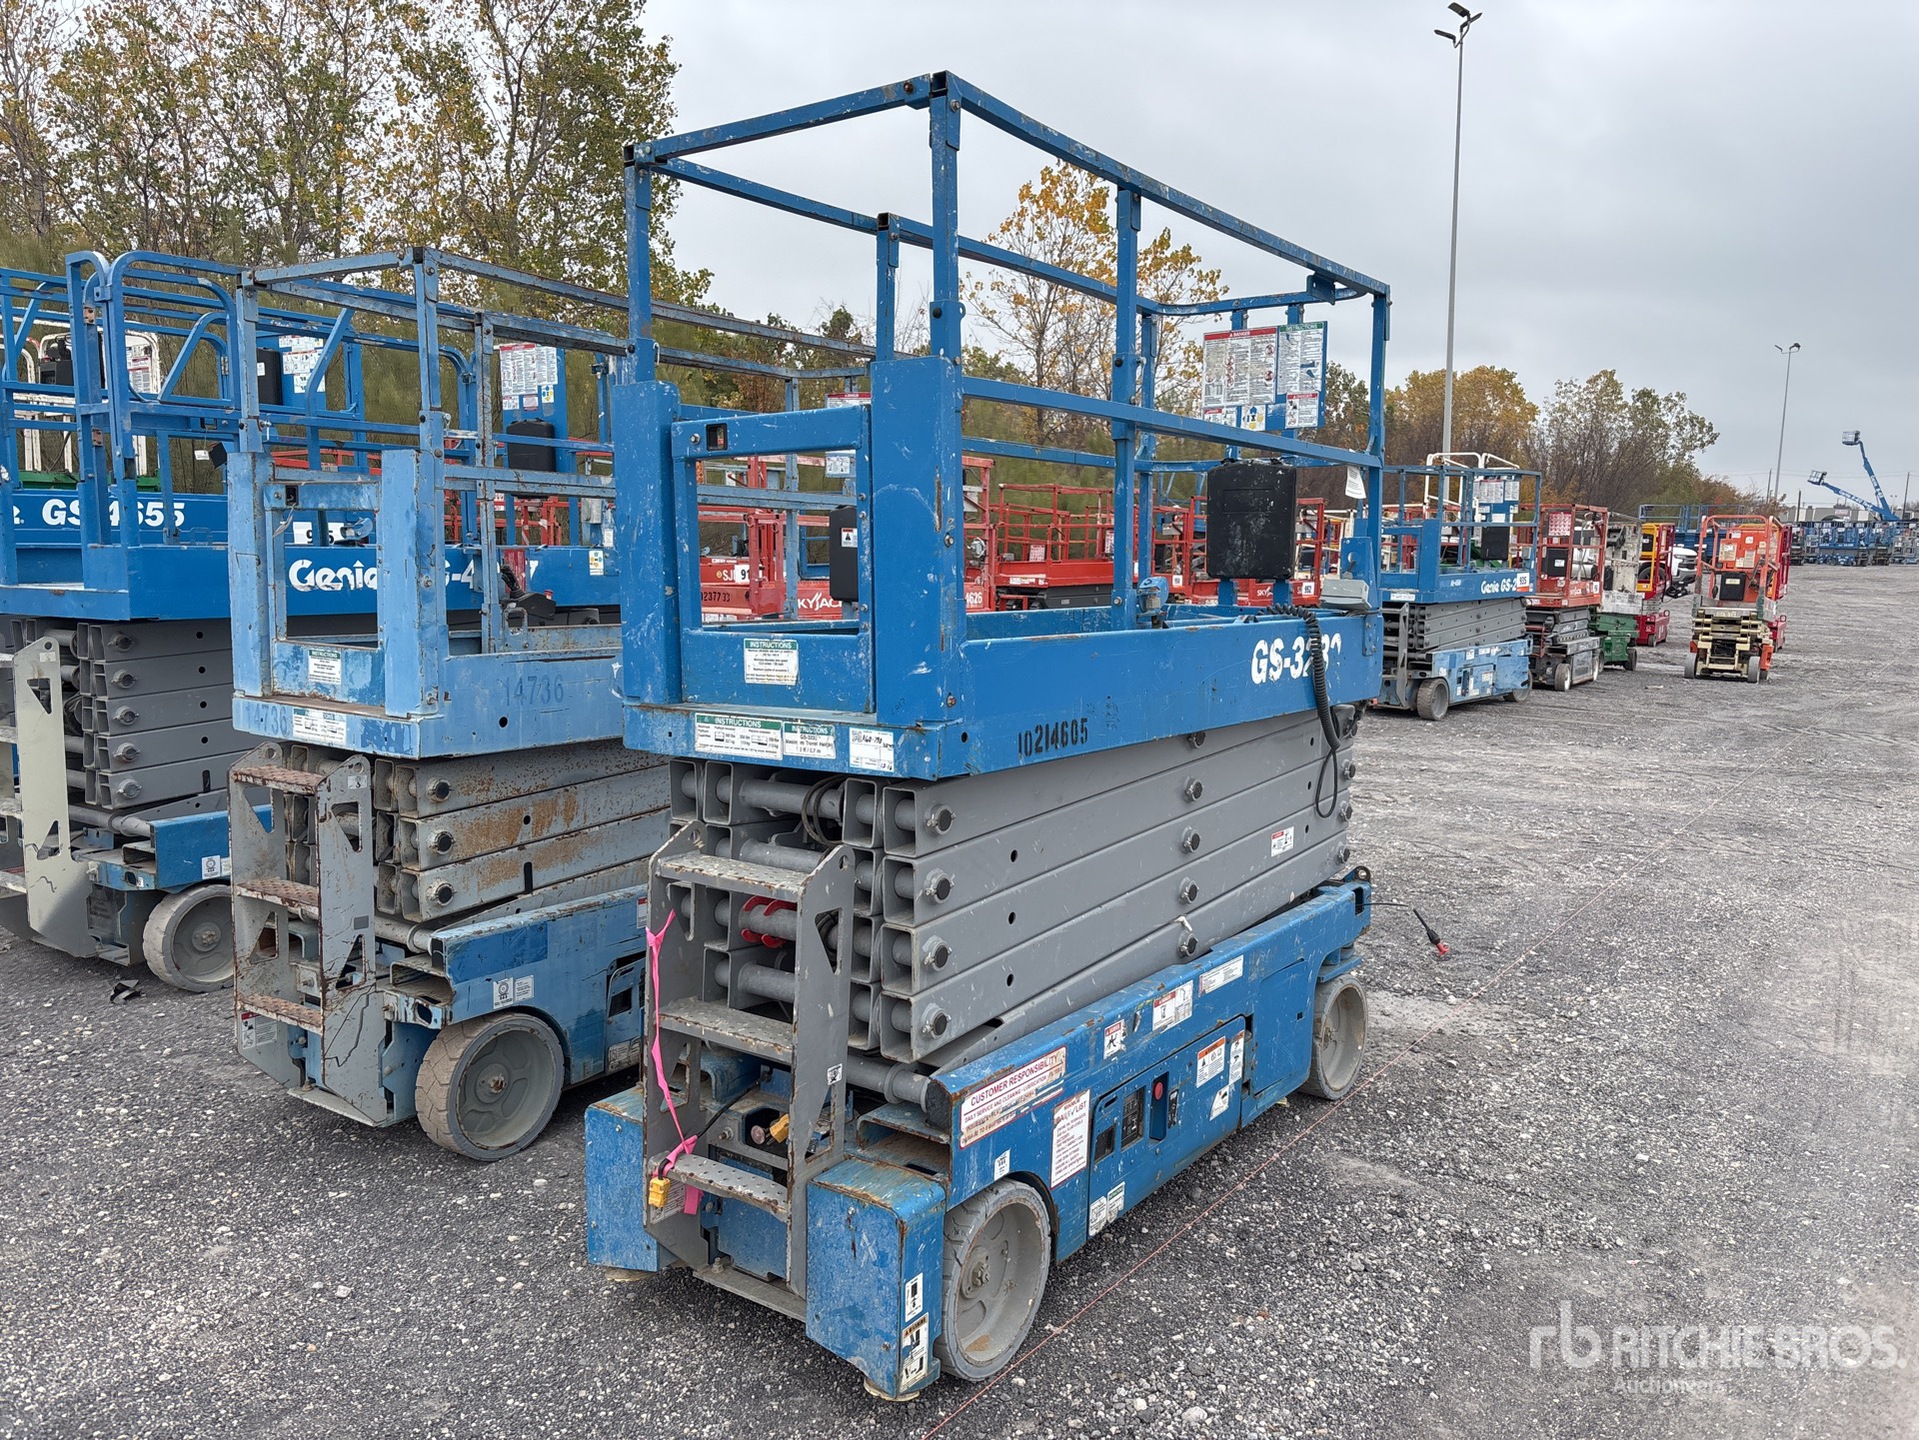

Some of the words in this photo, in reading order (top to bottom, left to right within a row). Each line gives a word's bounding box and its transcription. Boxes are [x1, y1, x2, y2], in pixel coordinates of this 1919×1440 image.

[42, 498, 186, 527] GS455
[797, 591, 843, 611] KYJAC
[750, 641, 792, 649] INSTRUCTIONS
[504, 673, 565, 707] 14736
[714, 717, 762, 729] INSTRUCTIONS
[791, 724, 829, 735] INSTRUCTIONS
[1018, 717, 1088, 757] 10214605
[970, 1080, 1009, 1106] CUSTOMER
[1008, 1054, 1058, 1086] RESPONSIBILITY
[964, 1111, 977, 1123] DAILY
[976, 1105, 994, 1118] SERVICE
[994, 1099, 1003, 1108] AND
[1002, 1089, 1021, 1103] CLEANING
[1023, 1075, 1047, 1092] LUBRICATION
